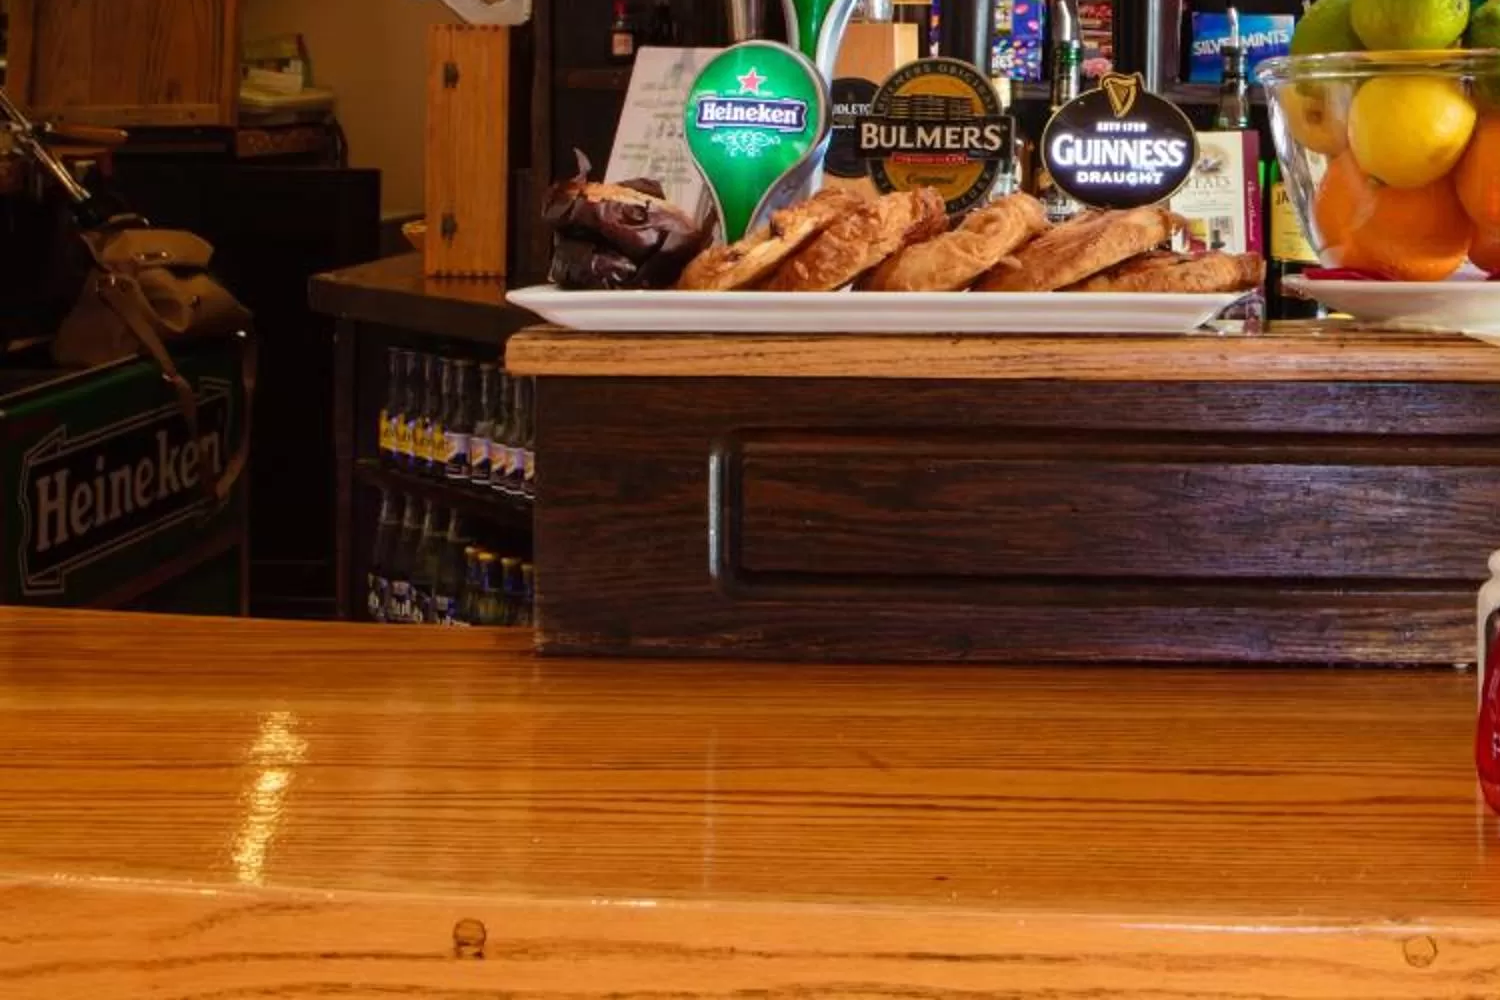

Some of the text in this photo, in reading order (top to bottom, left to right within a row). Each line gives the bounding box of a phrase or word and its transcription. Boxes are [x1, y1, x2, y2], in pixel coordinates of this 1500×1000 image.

[701, 102, 797, 124] Heineken
[860, 123, 1002, 150] BULMERS
[1052, 134, 1187, 167] GUINNESS
[1076, 171, 1164, 185] DRAUGHT
[35, 430, 221, 552] Heineken
